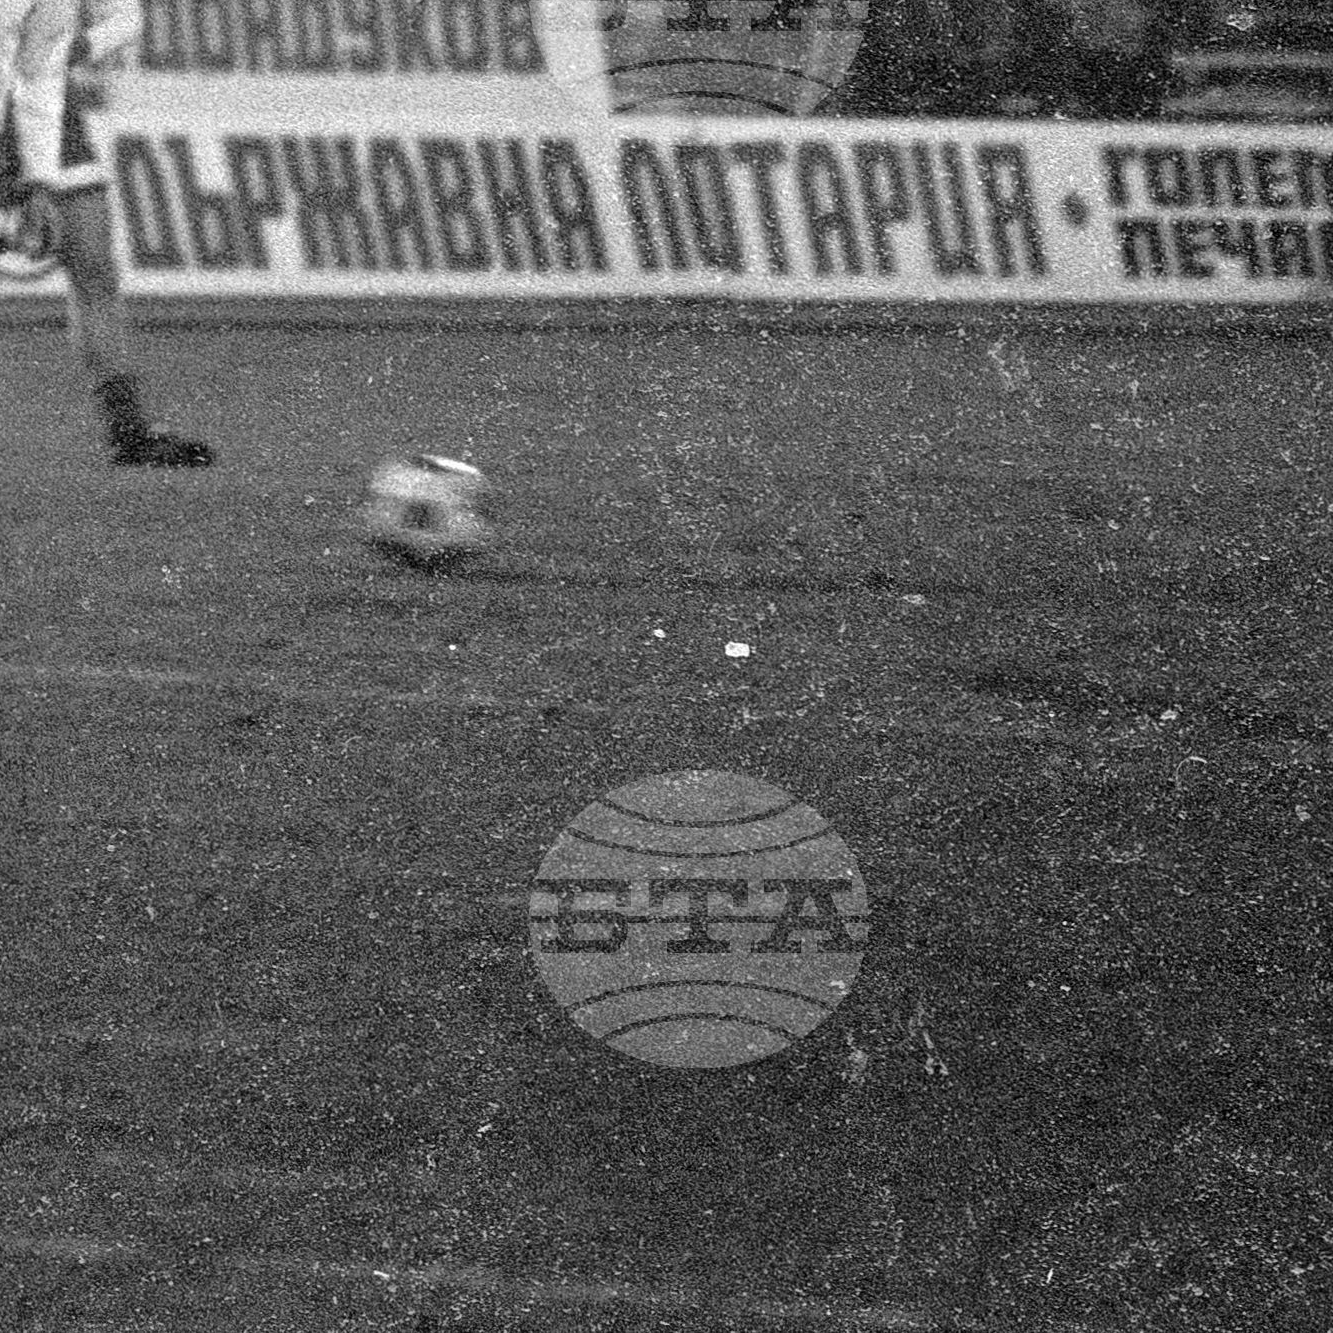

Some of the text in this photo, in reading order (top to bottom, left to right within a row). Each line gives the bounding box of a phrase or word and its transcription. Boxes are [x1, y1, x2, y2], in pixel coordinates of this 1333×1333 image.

[115, 134, 1050, 278] ДЪРЖАВНА ЛОТАРИЯ
[1115, 218, 1333, 279] ПЕЧА
